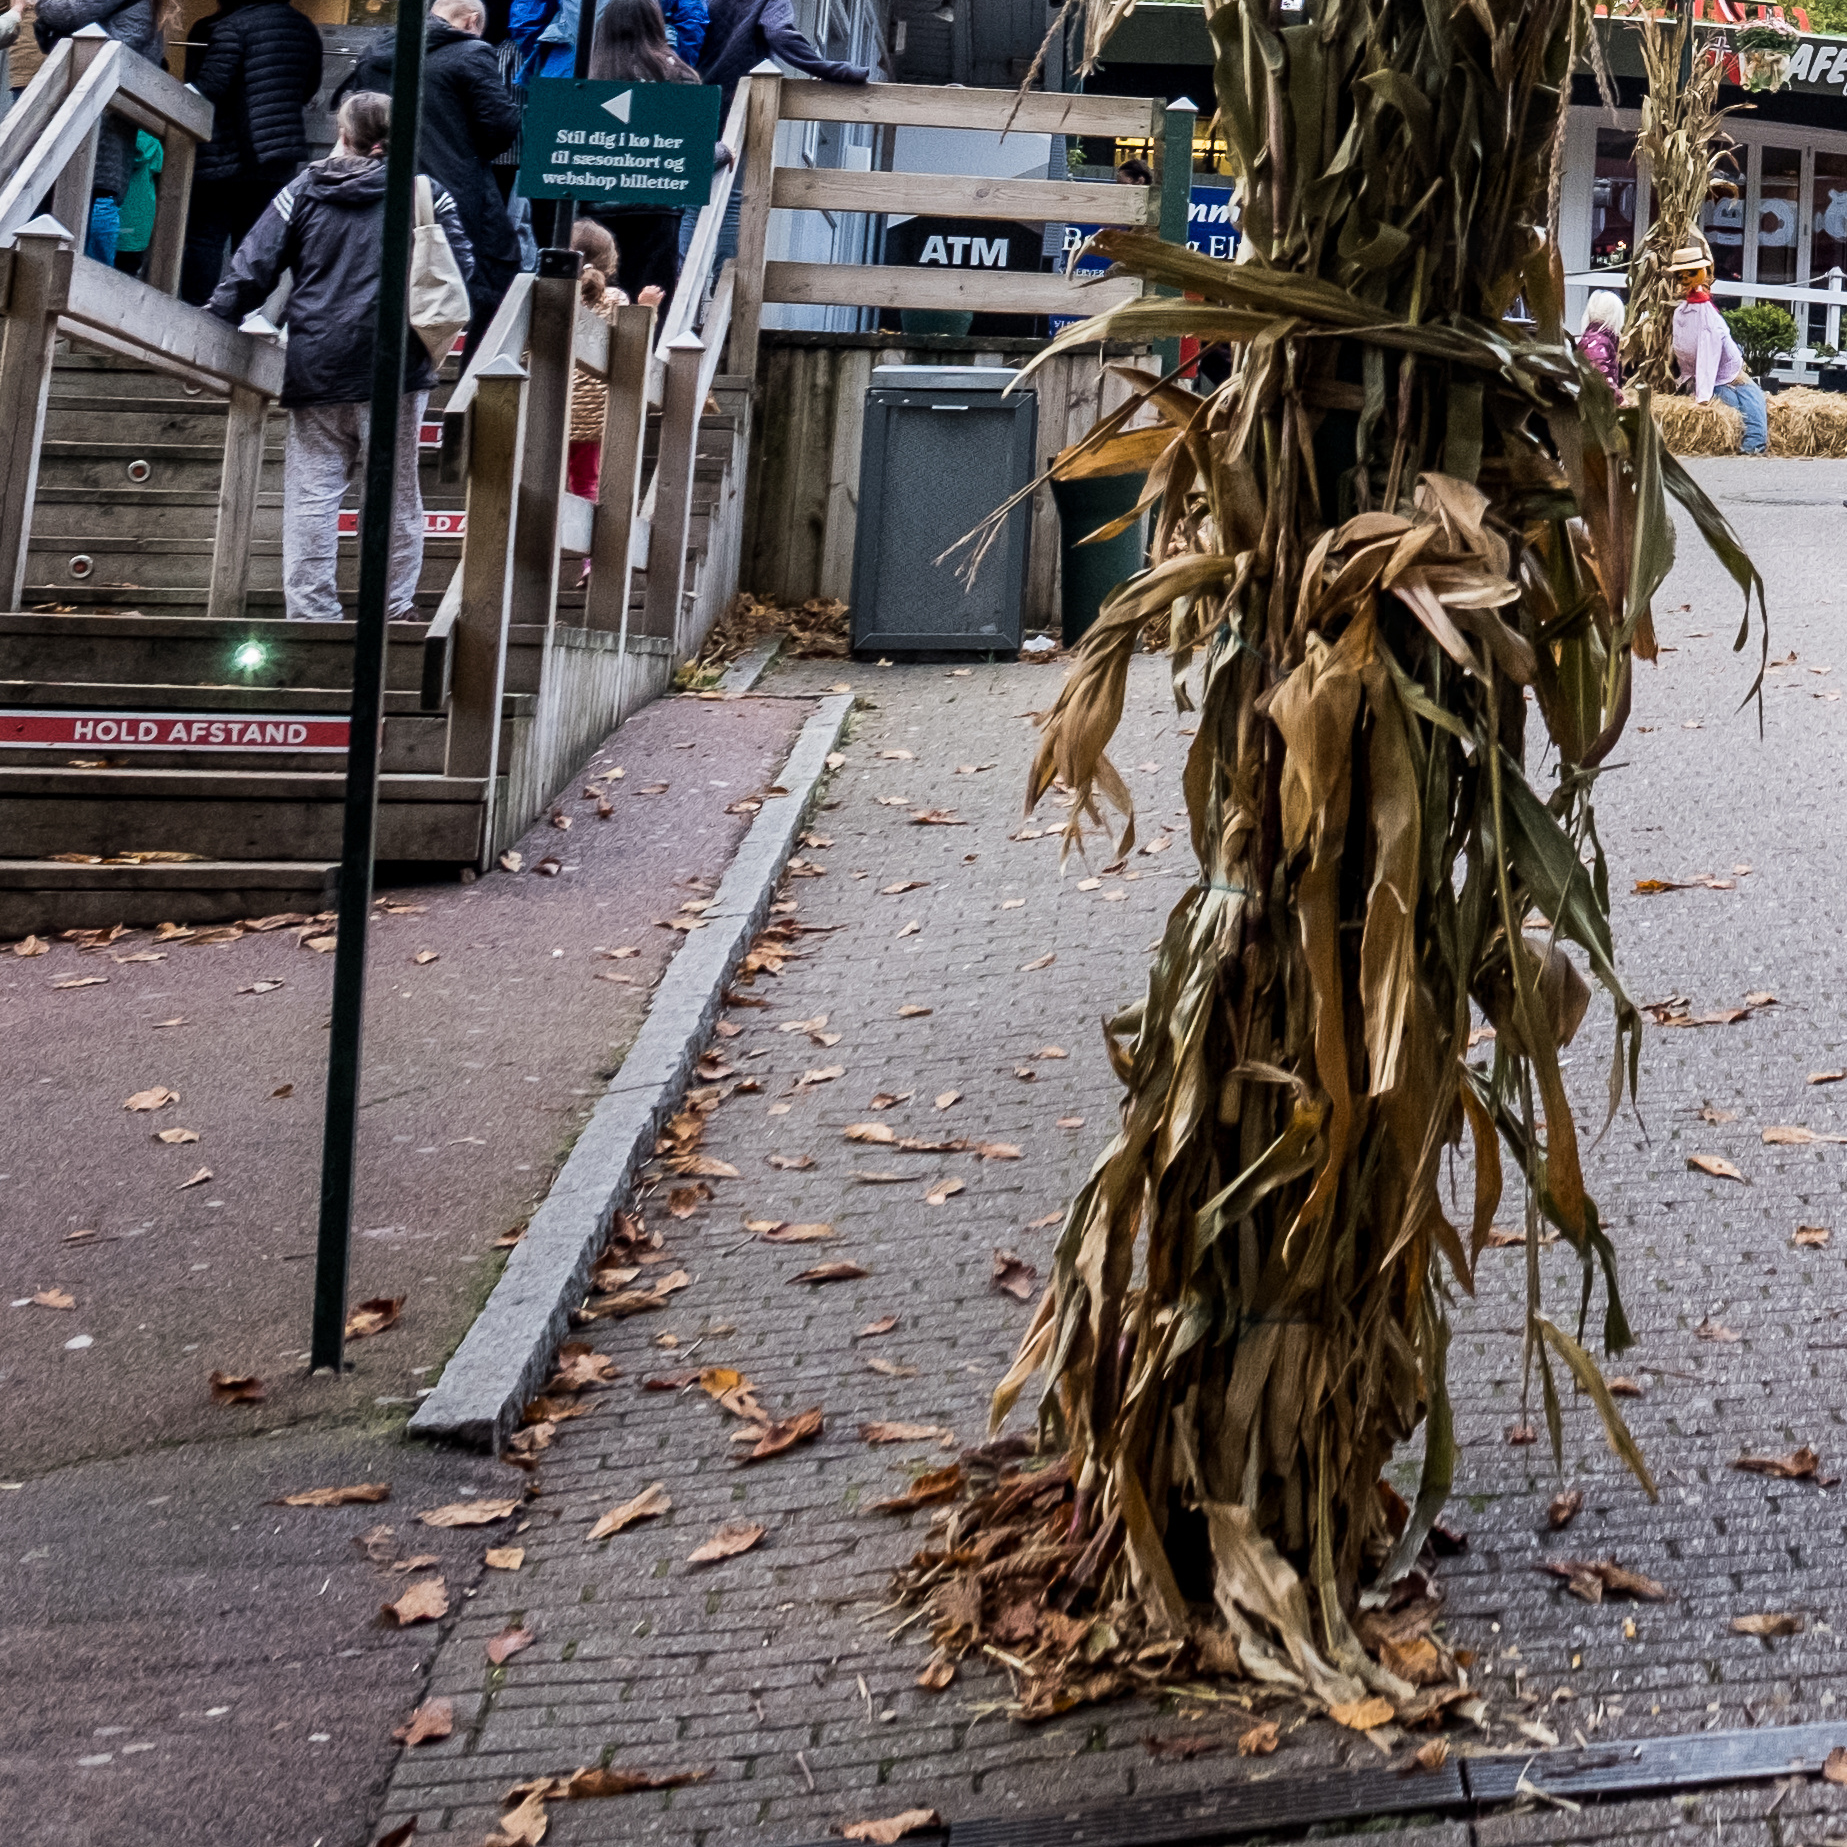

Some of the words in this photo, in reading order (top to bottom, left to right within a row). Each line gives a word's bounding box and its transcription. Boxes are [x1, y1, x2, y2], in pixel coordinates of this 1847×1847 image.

[555, 128, 587, 145] Stil
[588, 130, 616, 150] dig
[619, 131, 625, 147] i
[628, 132, 651, 148] kø
[652, 133, 684, 149] her
[550, 150, 569, 165] til
[572, 153, 661, 169] sæsonkort
[663, 156, 687, 174] og
[542, 171, 617, 191] webshop
[619, 173, 690, 191] billetter
[918, 235, 1010, 268] ATM
[73, 720, 158, 742] HOLD
[168, 722, 309, 745] AFSTAND
